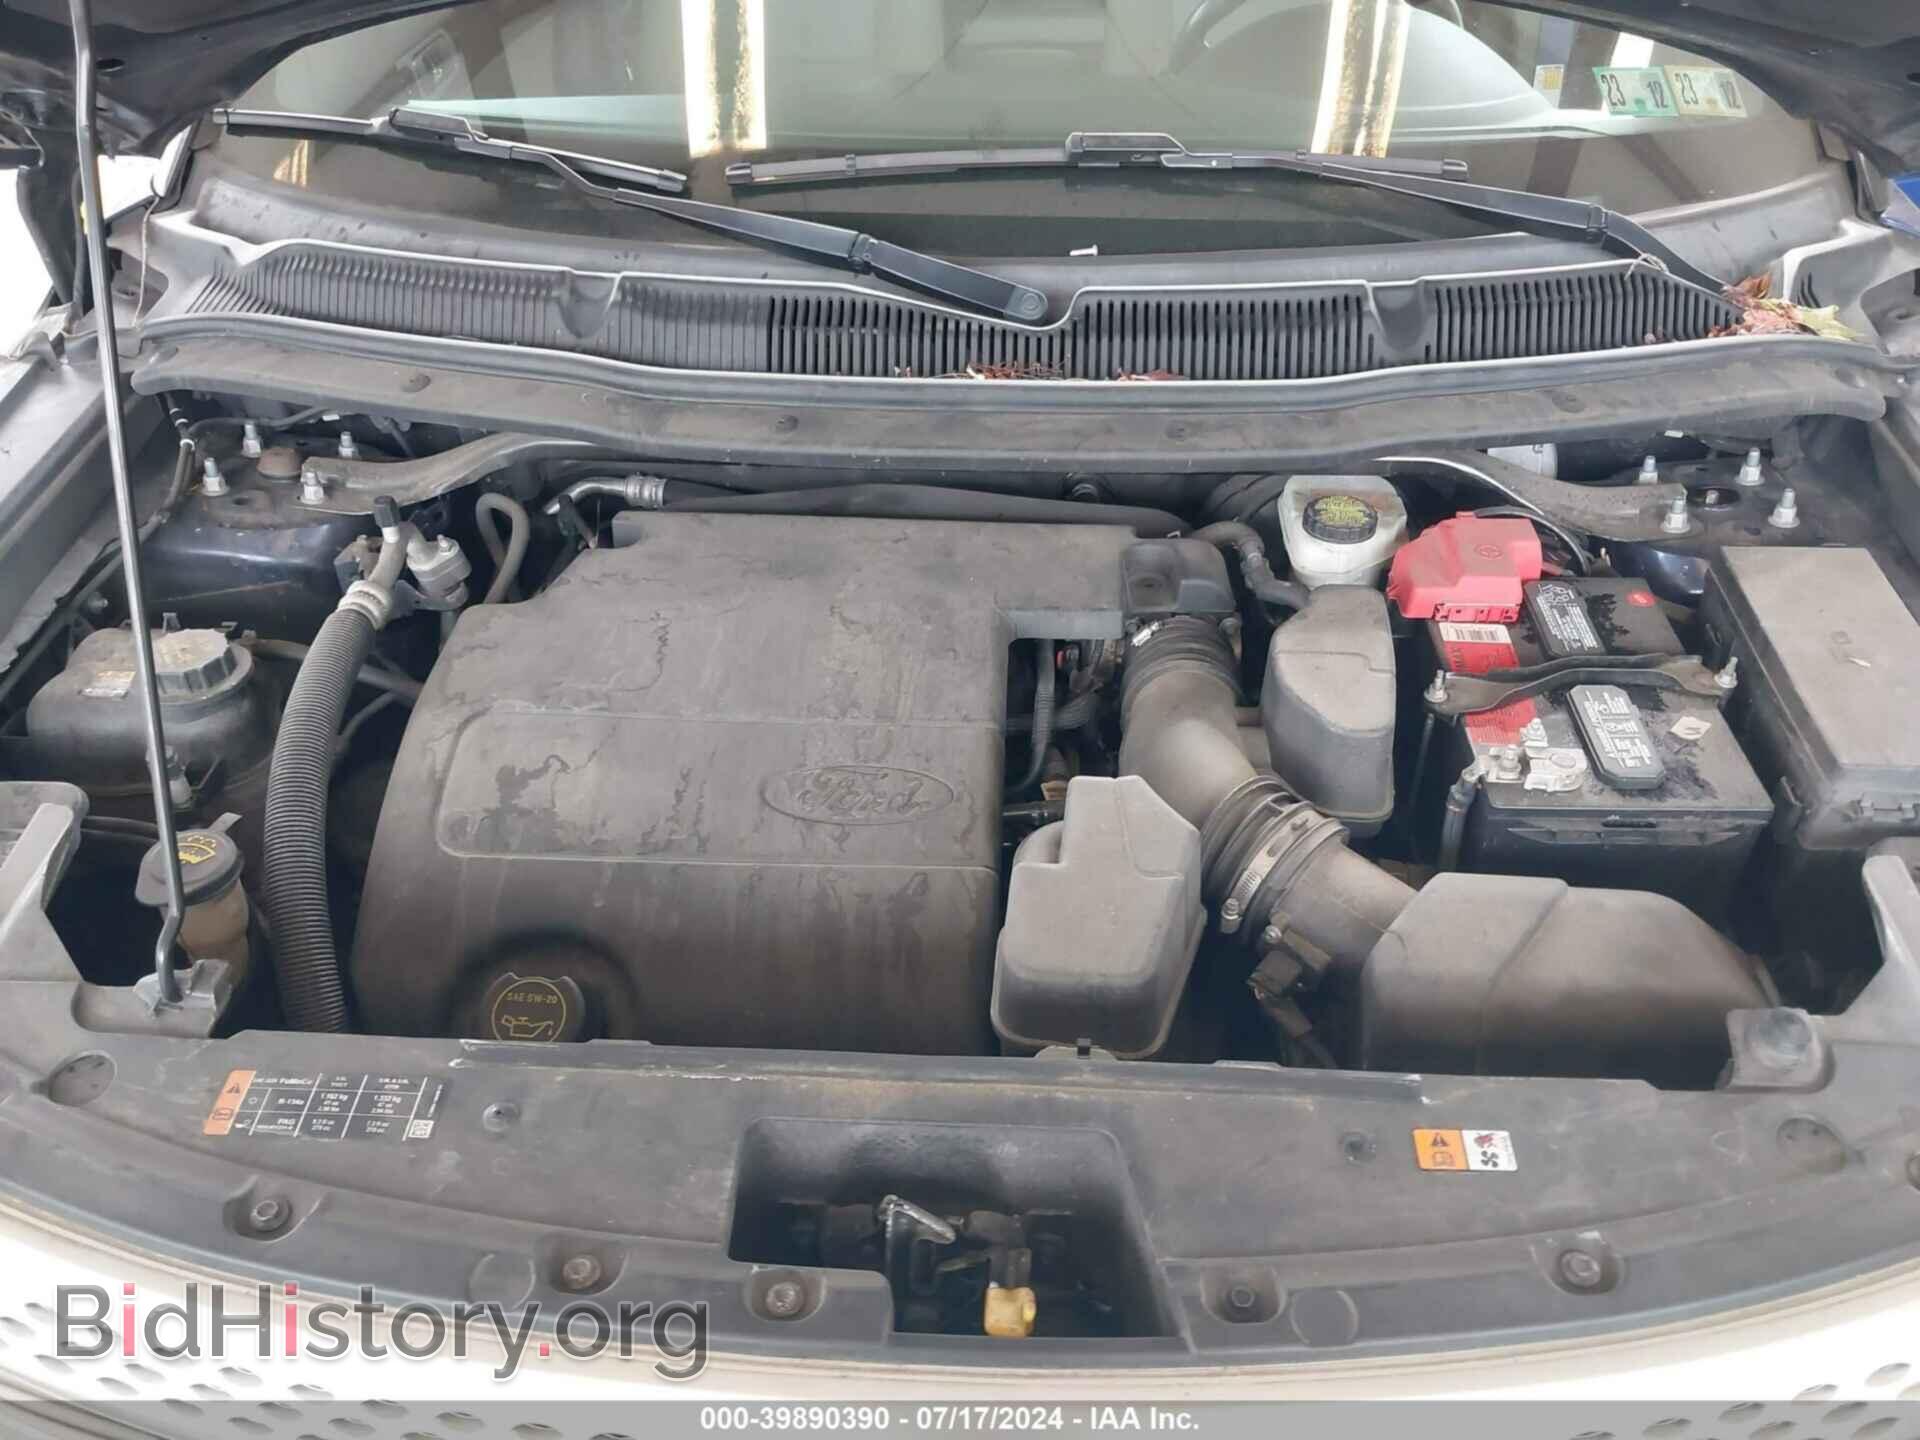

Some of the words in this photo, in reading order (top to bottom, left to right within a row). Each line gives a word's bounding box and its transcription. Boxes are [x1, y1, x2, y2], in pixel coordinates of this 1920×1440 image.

[1600, 73, 1627, 107] 23
[1645, 80, 1669, 109] 12
[1675, 72, 1699, 105] 23
[1719, 80, 1742, 109] 12
[796, 768, 932, 818] Ford
